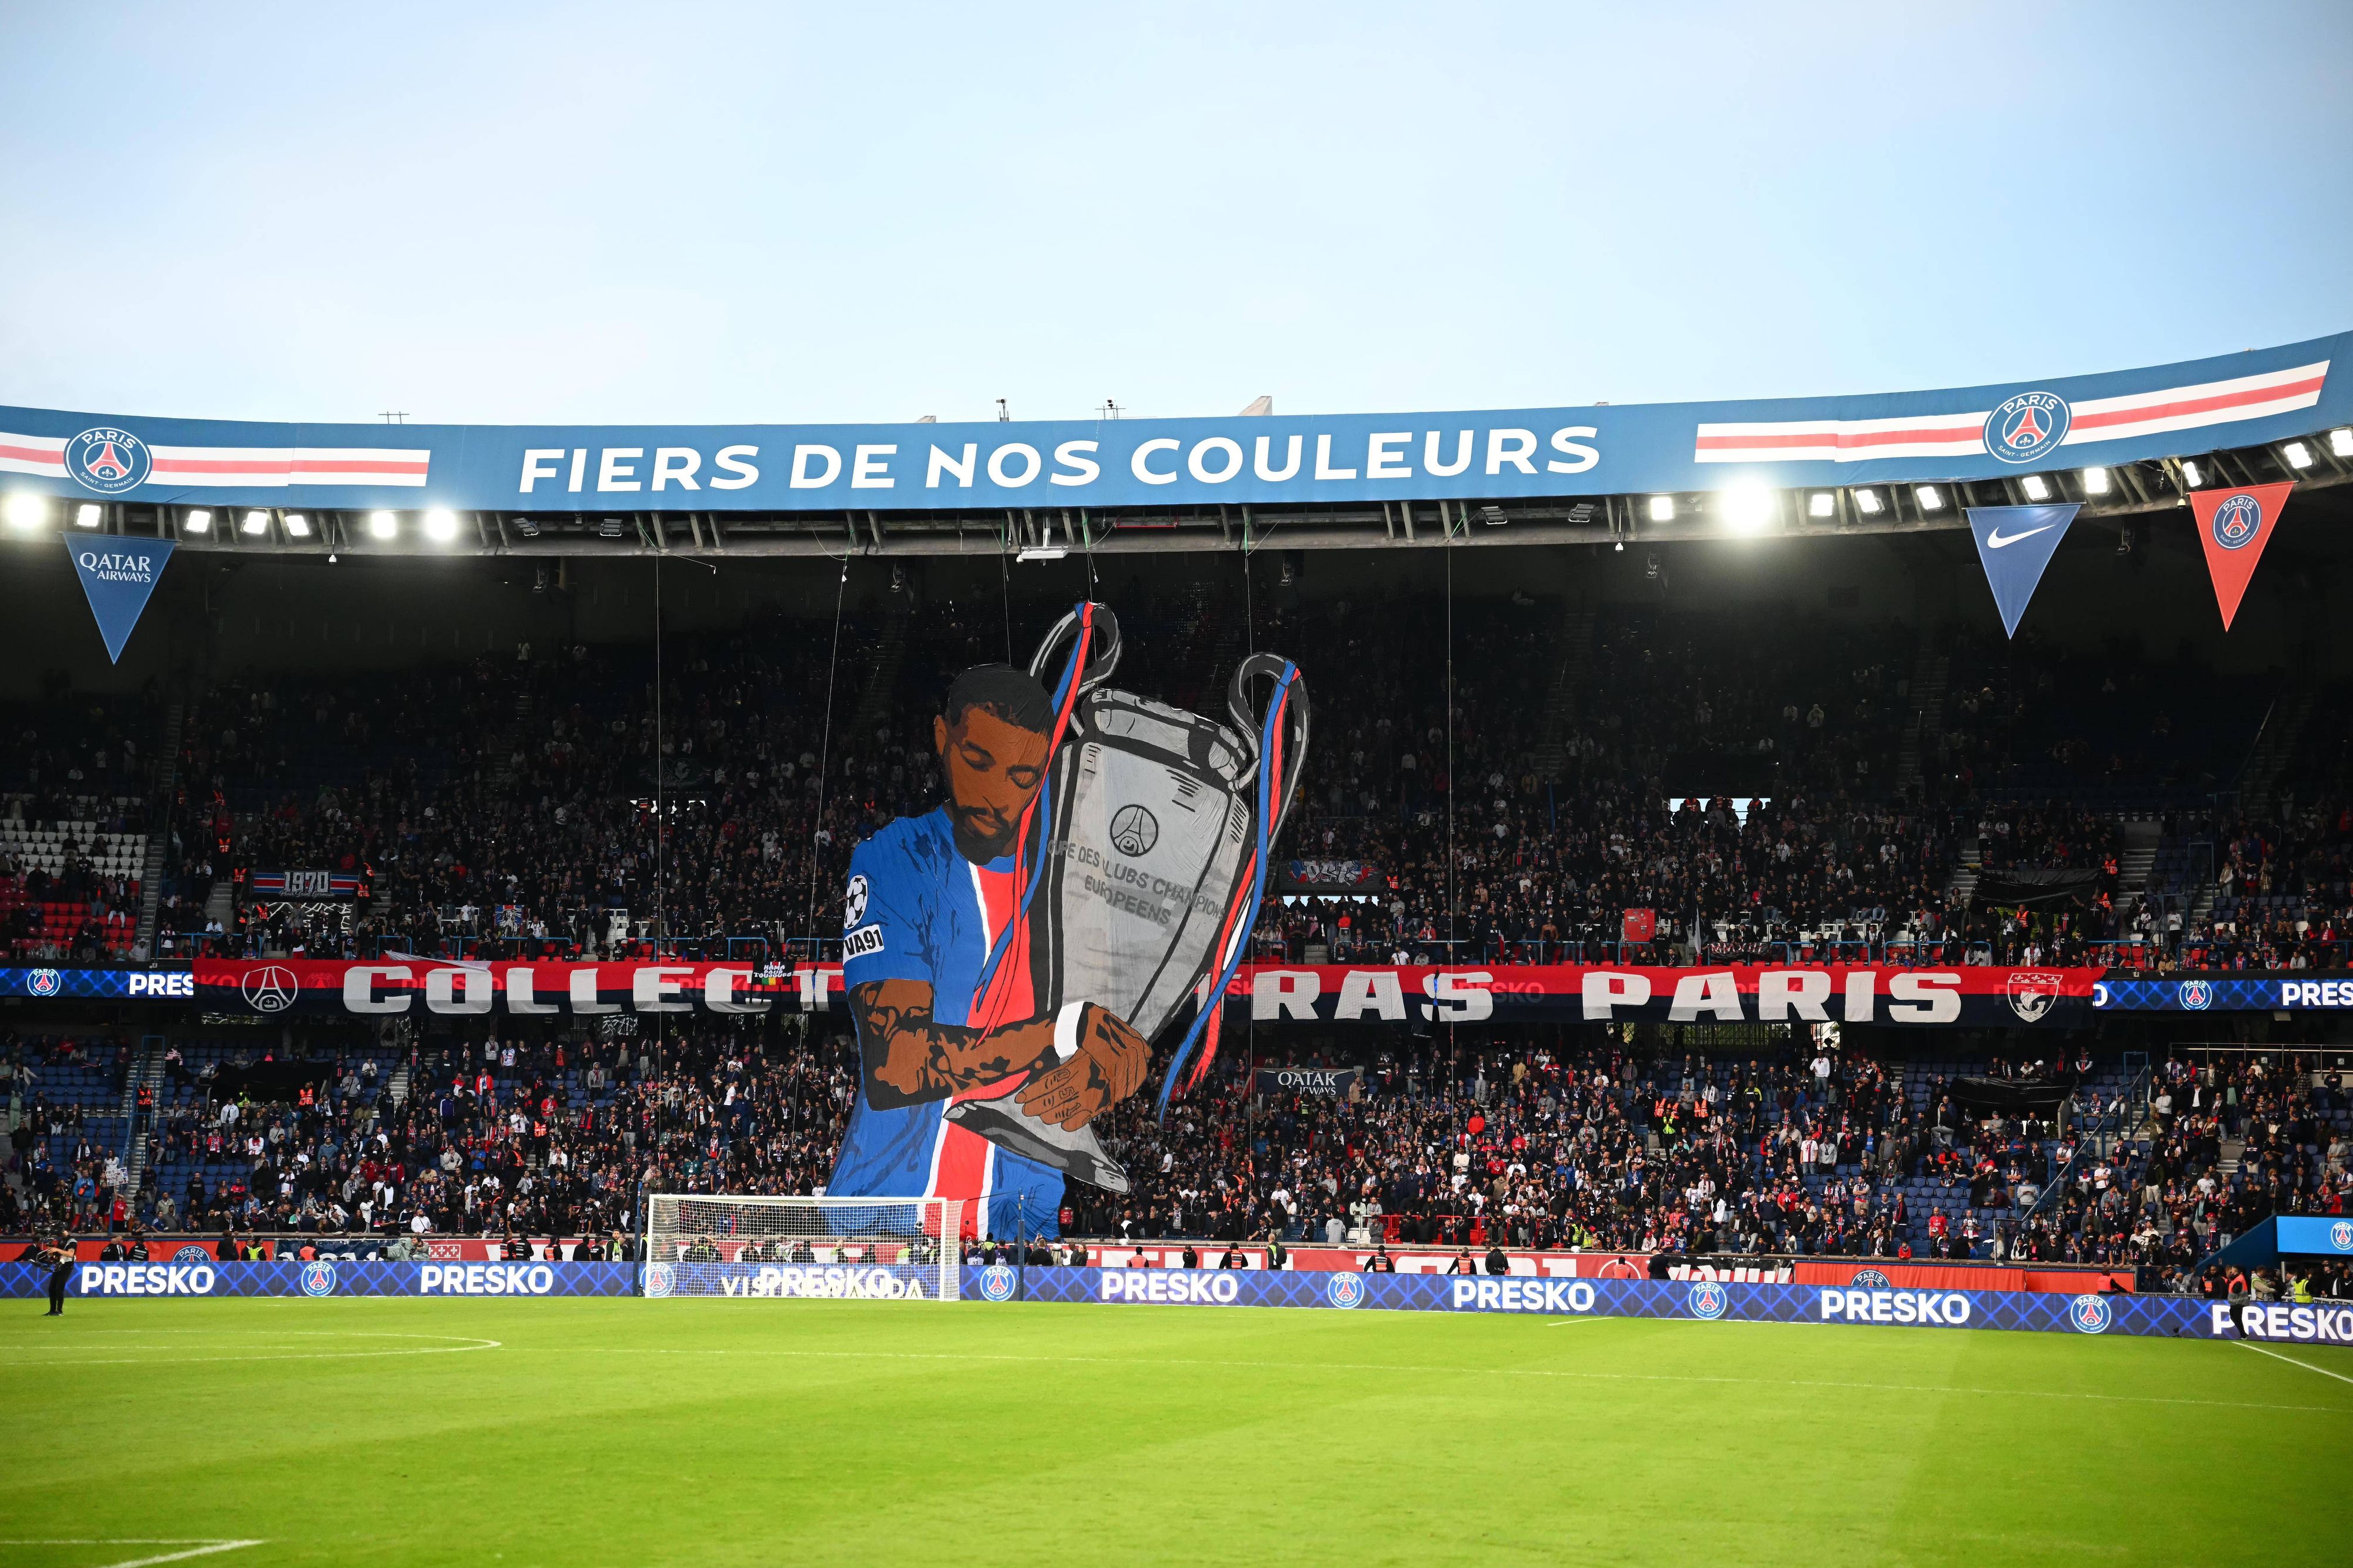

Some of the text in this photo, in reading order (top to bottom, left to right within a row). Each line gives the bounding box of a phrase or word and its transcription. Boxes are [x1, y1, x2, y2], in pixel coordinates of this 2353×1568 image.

[2003, 395, 2058, 413] PARIS
[81, 431, 136, 449] PARIS
[519, 426, 1600, 493] FIERS DE NOS COULEURS
[2223, 498, 2254, 512] PARIS
[79, 552, 151, 572] QATAR
[97, 570, 151, 583] AIRWAYS
[284, 870, 331, 893] 1970
[1047, 839, 1226, 920] OUPE DES LUBS CHAMPIONS
[844, 929, 884, 956] VA91
[33, 968, 55, 976] PARIS
[2184, 980, 2207, 989] PARIS
[1582, 970, 1961, 1022] PARIS
[1278, 1072, 1336, 1088] QATAR
[2334, 1223, 2351, 1231] PARIS
[179, 1248, 205, 1258] PARIS
[308, 1262, 331, 1272] PARIS
[986, 1267, 1009, 1277] PARIS
[81, 1266, 215, 1294] PRESKO
[420, 1266, 553, 1294] PRESKO
[1334, 1273, 1358, 1283] PARIS
[1857, 1272, 1884, 1283] PARIS
[1102, 1272, 1238, 1302] PRESKO
[1454, 1280, 1595, 1312] PRESKO
[1695, 1283, 1720, 1293] PARIS
[1821, 1290, 1970, 1324] PRESKO
[2077, 1296, 2104, 1307] PARIS
[2212, 1305, 2353, 1341] PRESKO
